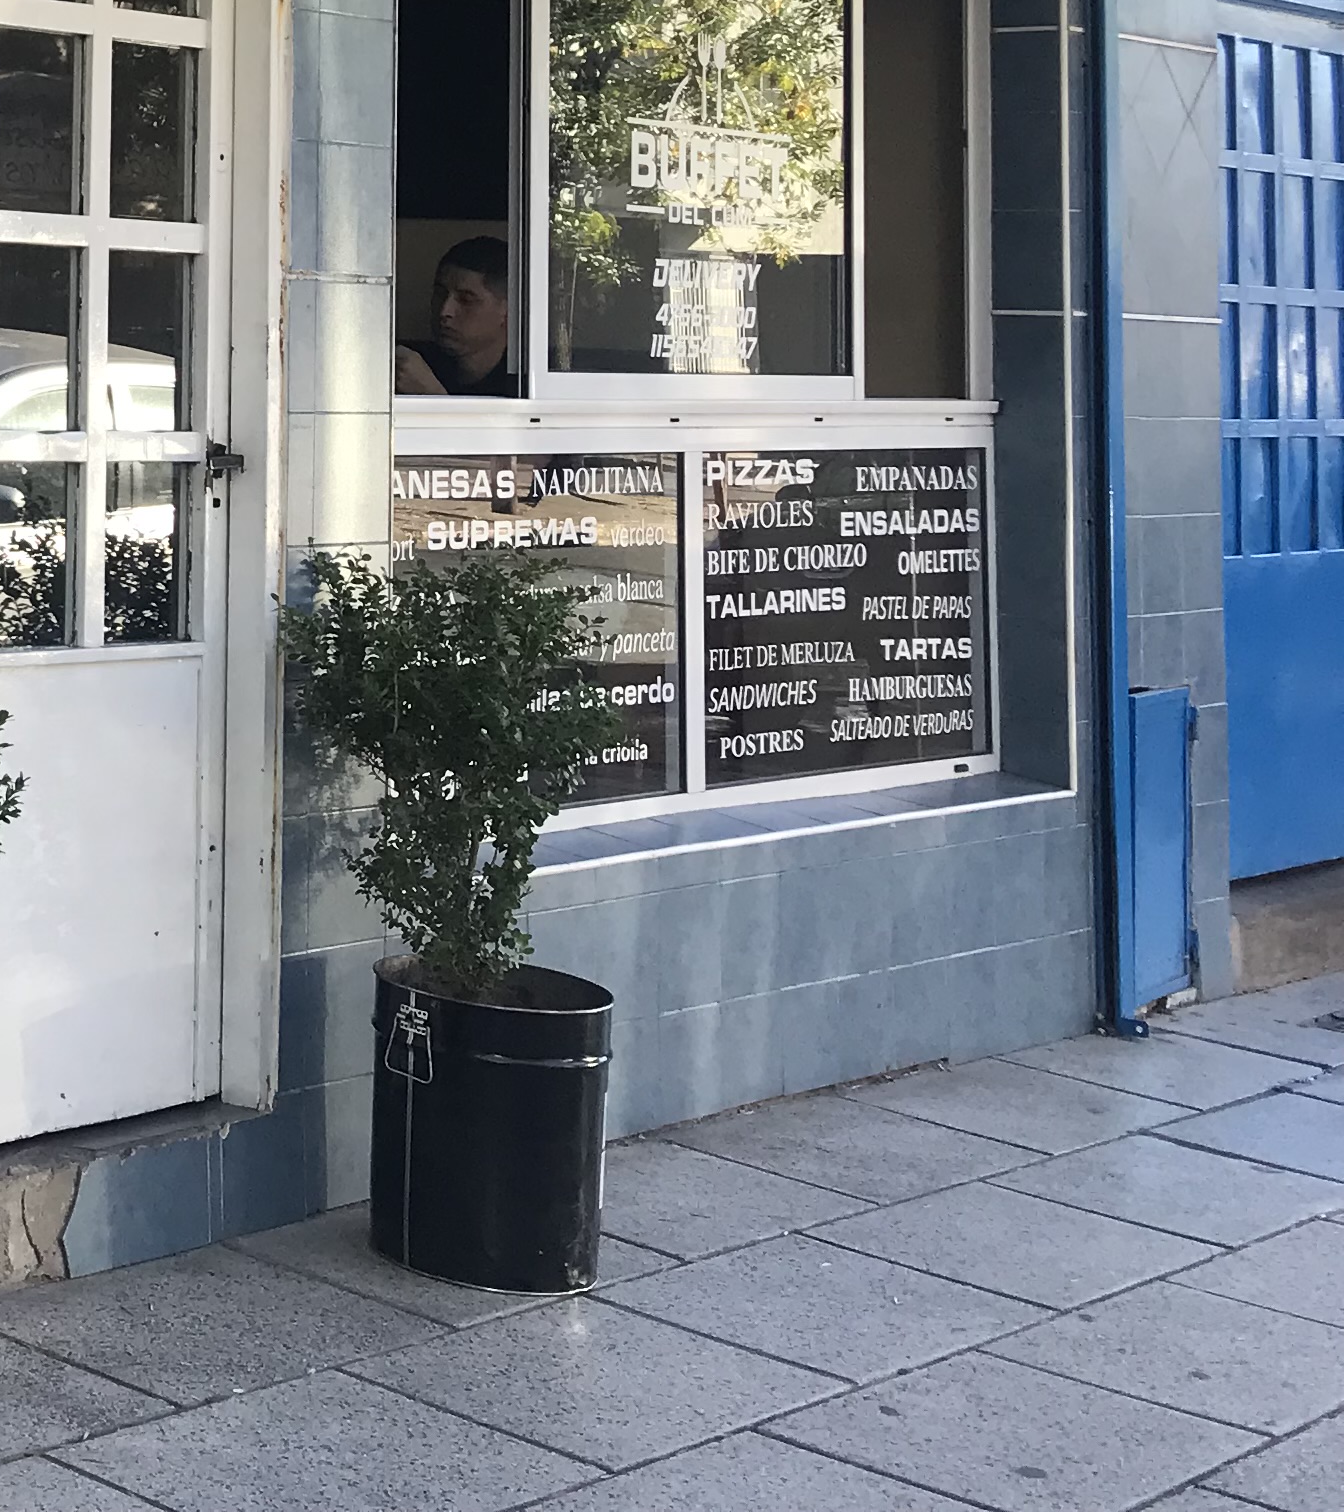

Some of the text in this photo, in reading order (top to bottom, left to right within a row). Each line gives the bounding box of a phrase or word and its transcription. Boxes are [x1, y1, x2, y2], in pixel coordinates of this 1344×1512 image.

[630, 130, 789, 204] BUFFET
[668, 203, 753, 227] DEL CUM
[652, 258, 762, 292] DELIVERY
[532, 465, 664, 498] NAPOLITANA
[706, 458, 978, 492] PIZZAS EMPANADAS
[427, 516, 665, 551] SUPREMAS verdeo
[707, 500, 981, 537] RAVIOLES ENSALADAS
[707, 543, 981, 576] BIFE DE CHORIZO OMELETTES
[616, 572, 664, 602] blanca
[706, 587, 973, 622] TALLARINES PASTEL DE PAPAS
[613, 628, 675, 661] panceta
[709, 637, 973, 672] FILET DE MERLUZA TARTAS
[612, 675, 675, 706] cerdo
[708, 673, 973, 714] SANDWICHES HAMBURGUESAS
[719, 709, 974, 759] POSTRES SALTEADO DE VERDURAS
